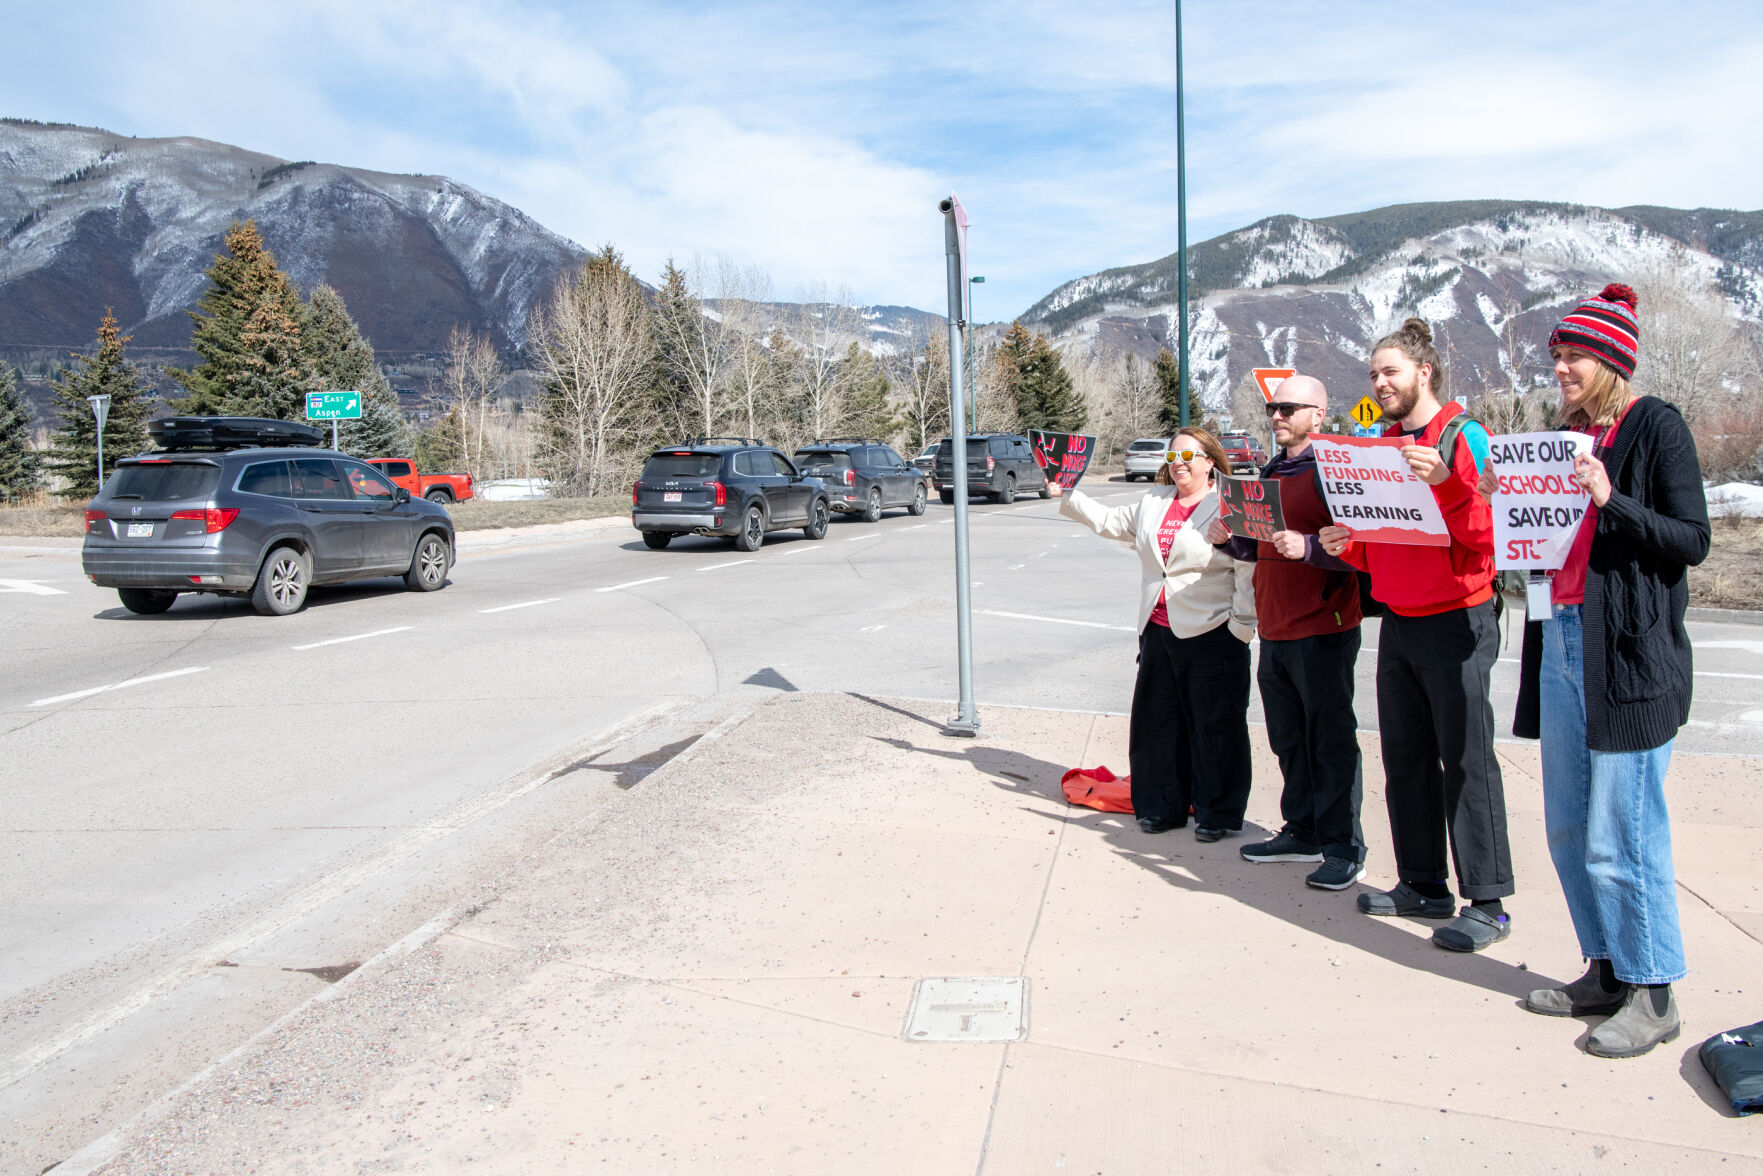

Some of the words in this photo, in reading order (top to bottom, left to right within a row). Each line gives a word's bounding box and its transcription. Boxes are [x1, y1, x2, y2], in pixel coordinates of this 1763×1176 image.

[315, 409, 340, 417] Aspen
[1068, 434, 1087, 453] NO
[1491, 442, 1535, 464] SAVE
[1538, 440, 1577, 462] OUR
[1061, 453, 1087, 471] MORE
[1315, 449, 1352, 464] LESS
[1323, 466, 1405, 483] FUNDING
[1241, 480, 1264, 501] NO
[1326, 482, 1364, 495] LESS
[1498, 473, 1586, 499] SCHOOLS,
[1242, 501, 1274, 524] MORE
[1332, 505, 1423, 521] LEARNING
[1508, 507, 1555, 528] SAVE
